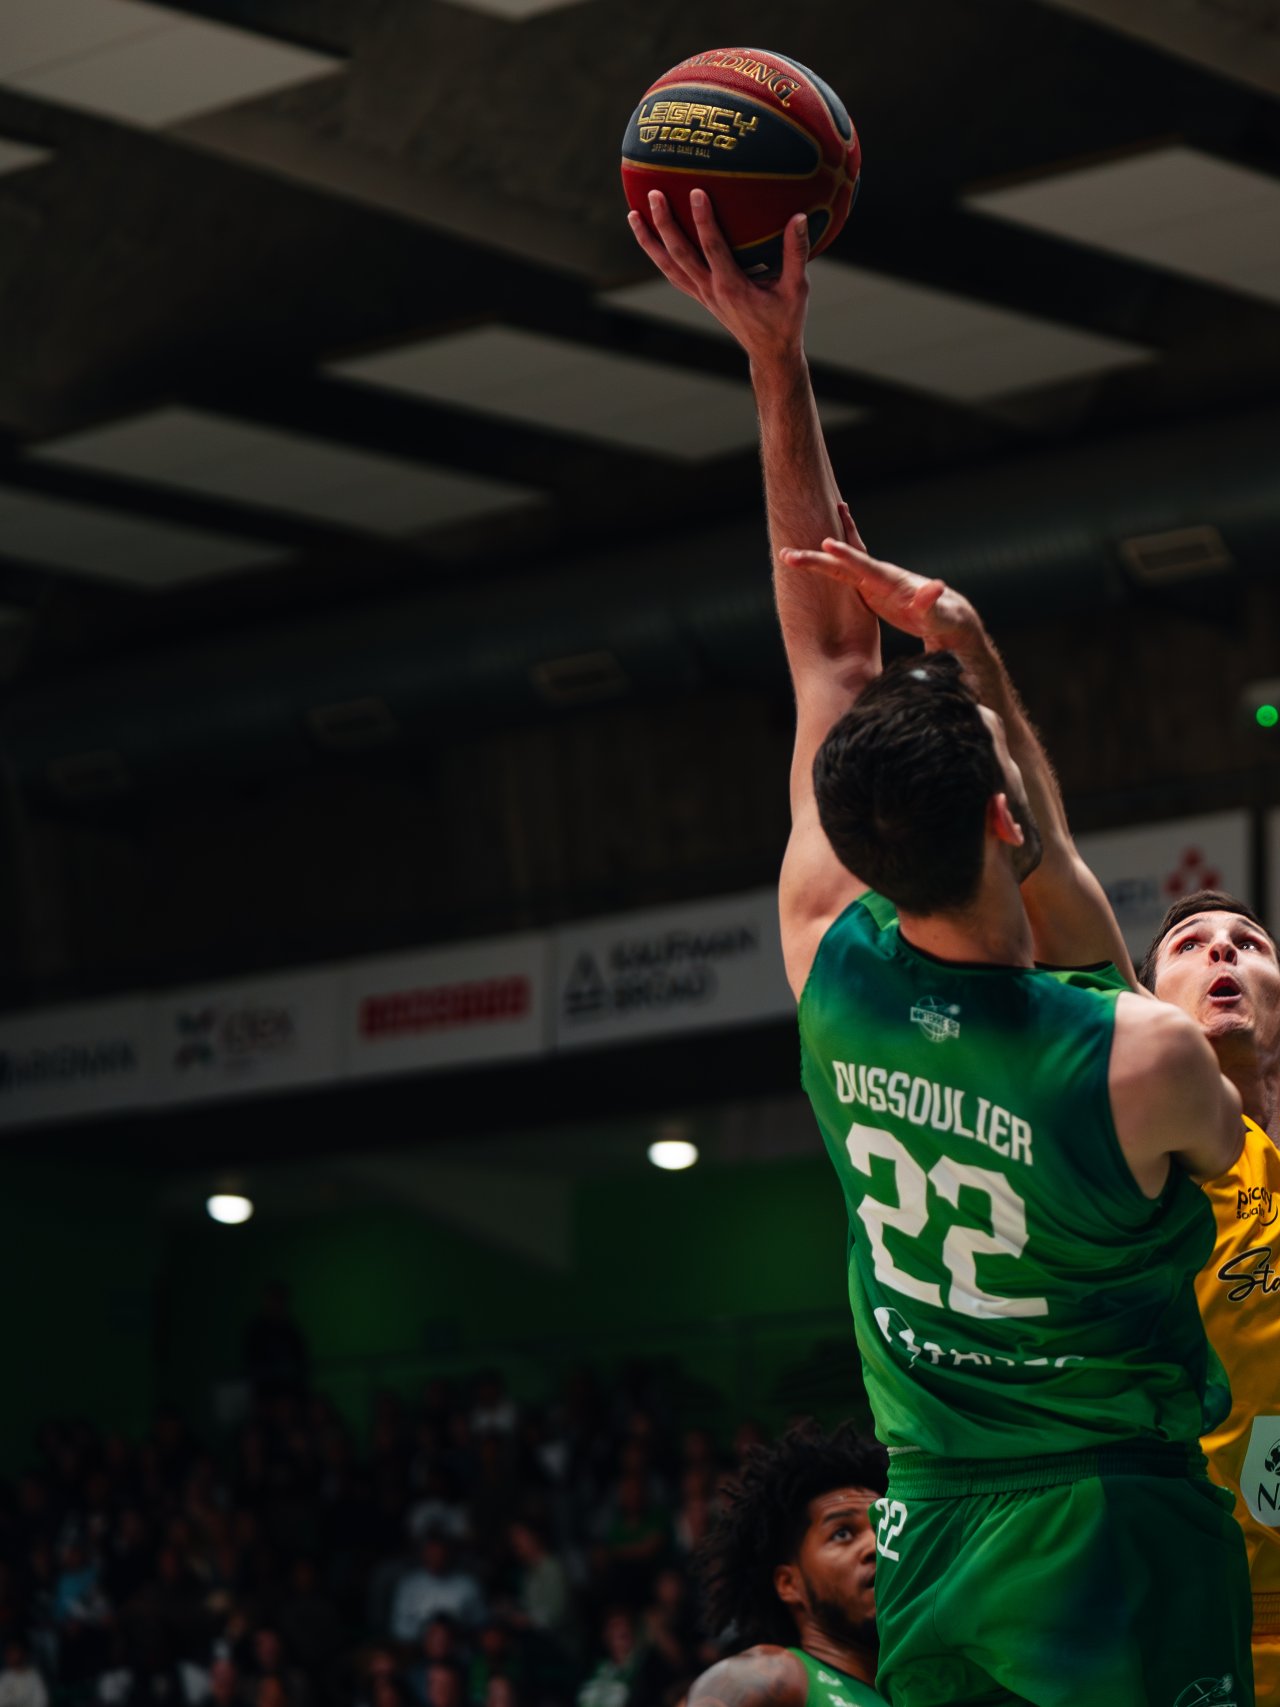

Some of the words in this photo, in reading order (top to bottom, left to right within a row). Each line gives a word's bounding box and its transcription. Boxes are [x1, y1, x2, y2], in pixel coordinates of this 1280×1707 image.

[662, 54, 801, 108] ALDING
[637, 101, 759, 137] LEGACY
[659, 126, 738, 150] 1000
[832, 1060, 1033, 1166] DUSSOULIER
[845, 1122, 1049, 1319] 22
[1237, 1186, 1273, 1213] picy
[875, 1498, 908, 1562] 22
